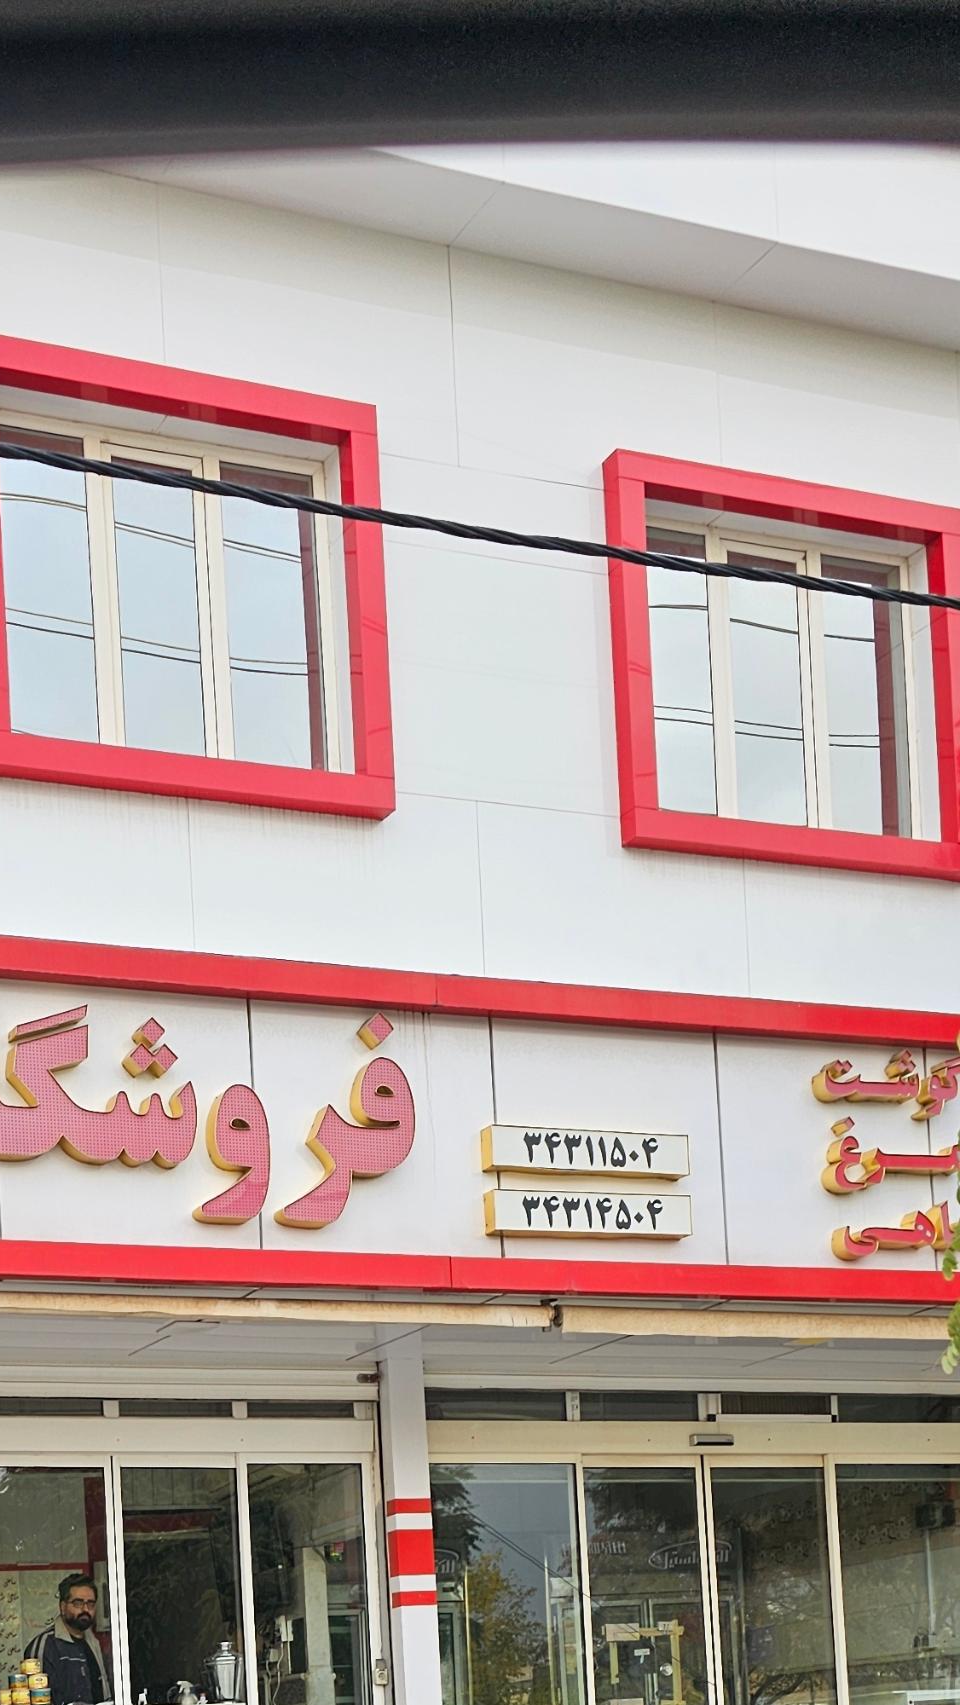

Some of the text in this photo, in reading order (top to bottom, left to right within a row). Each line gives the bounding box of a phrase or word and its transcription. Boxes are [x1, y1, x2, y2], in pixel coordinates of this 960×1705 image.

[523, 1131, 659, 1169] ۳۴۳۱۱۵۰۴
[821, 1116, 960, 1196] رغ
[522, 1195, 663, 1230] ۳۴۳۱۴۵۰۴
[831, 1200, 960, 1261] اهی
